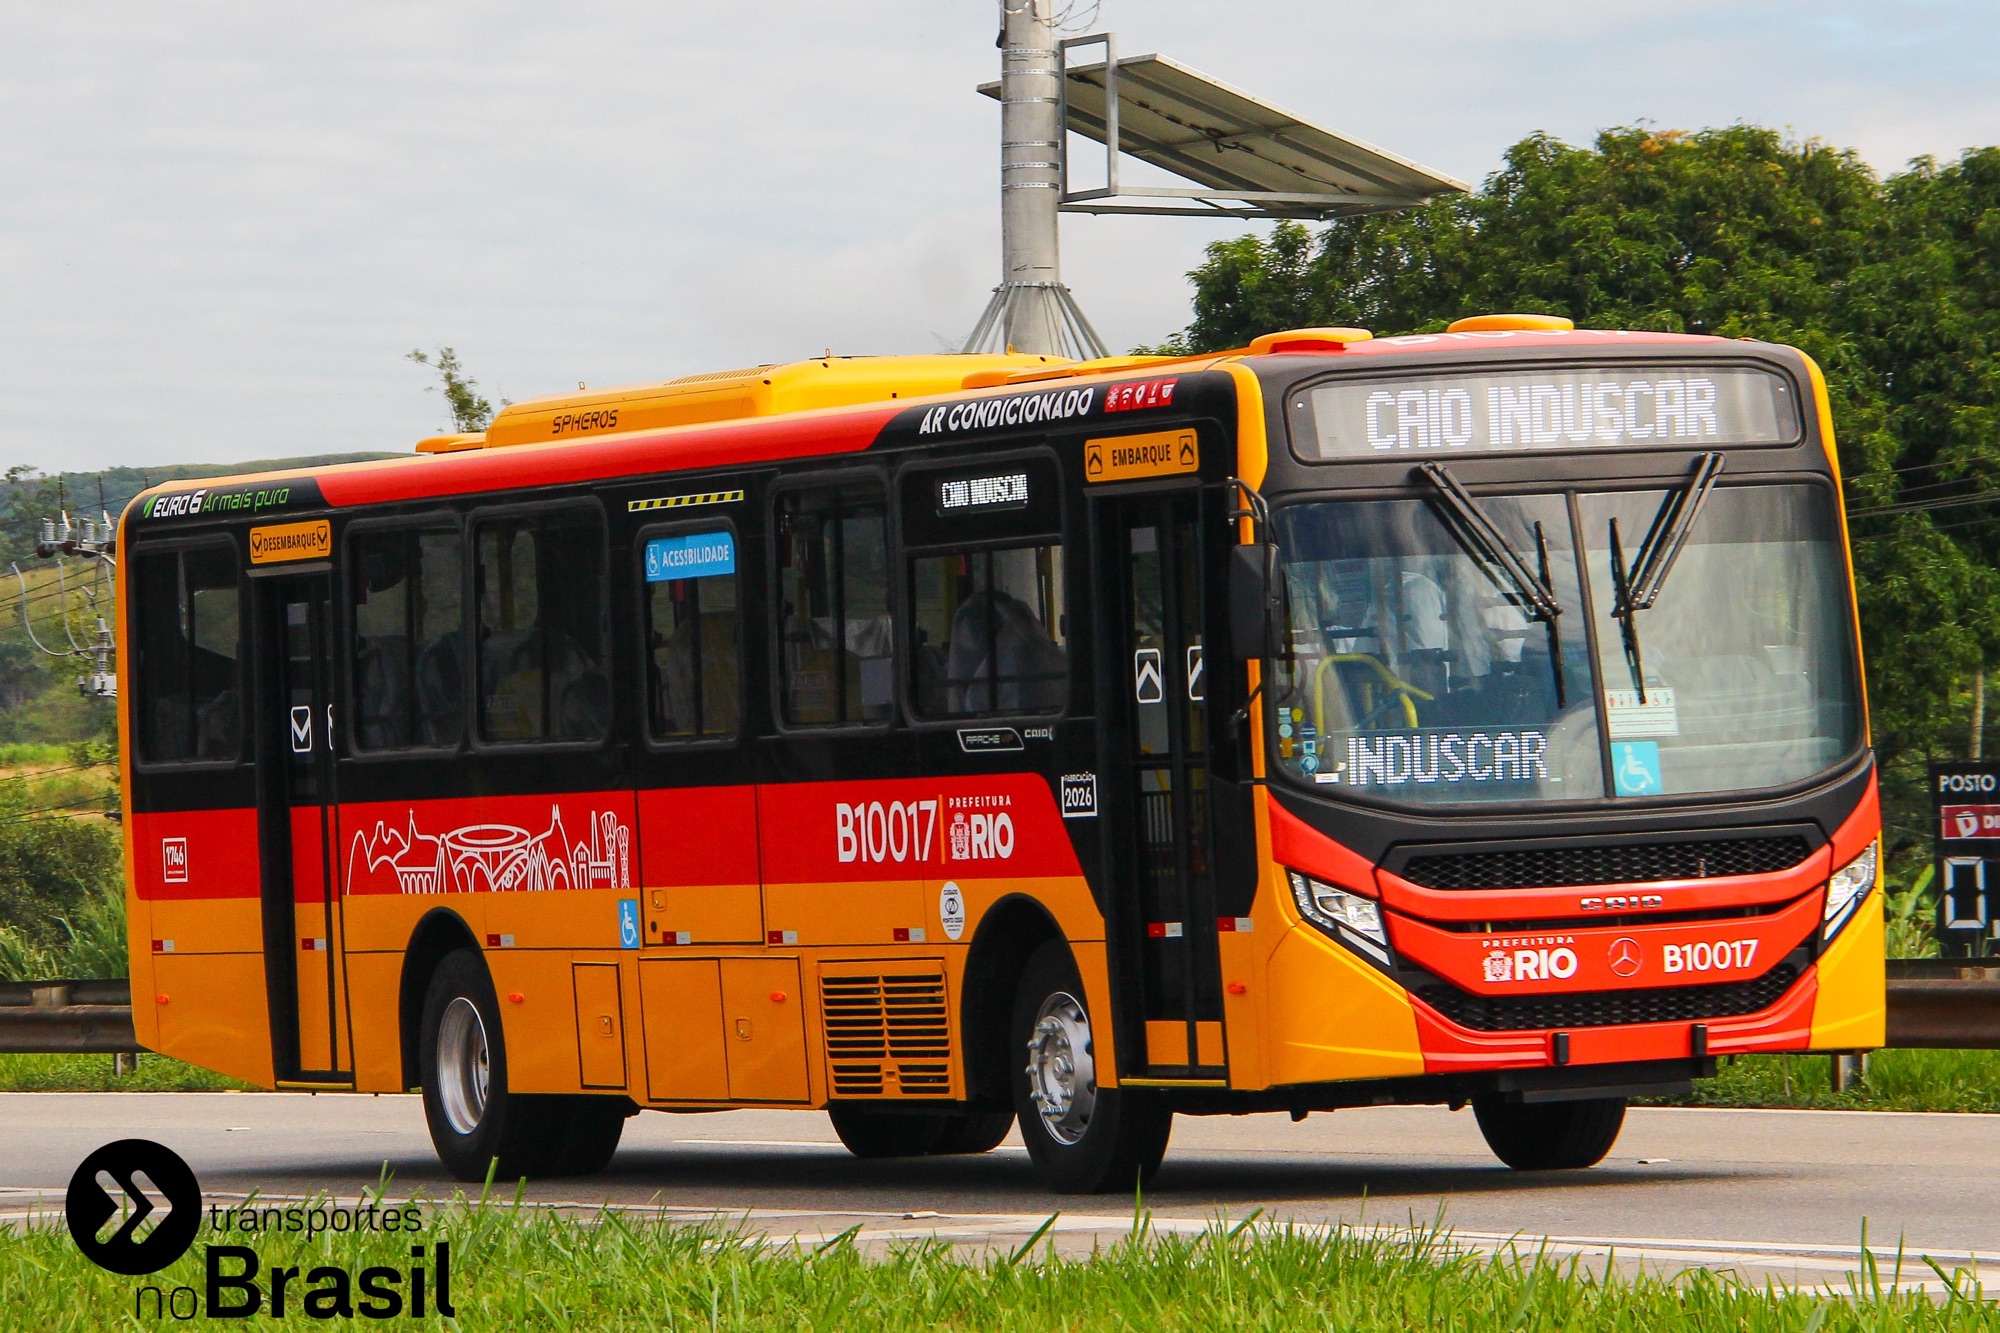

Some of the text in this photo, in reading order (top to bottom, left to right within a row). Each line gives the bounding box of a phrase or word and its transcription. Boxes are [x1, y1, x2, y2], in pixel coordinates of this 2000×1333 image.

[552, 409, 619, 434] SPHEROS
[919, 387, 1095, 435] AR CONDICIONADO
[1366, 378, 1717, 450] CAIO INDUSCAR
[1112, 444, 1171, 467] EMBARQUE
[254, 488, 290, 512] puro
[263, 533, 317, 552] DESEMBARQUE
[966, 735, 1000, 744] APACHE
[1024, 729, 1048, 738] CAIO
[1347, 730, 1548, 786] INDUSCAR
[1939, 774, 1996, 792] POSTO
[949, 795, 1012, 808] PREFEITURA
[1065, 787, 1092, 807] 2026
[836, 800, 937, 863] B10017
[970, 812, 1014, 860] RIO
[166, 846, 184, 866] 1746
[1580, 895, 1662, 911] CAIO
[1482, 936, 1574, 948] PREFEITURA
[1515, 948, 1578, 980] RIO
[1663, 939, 1759, 973] B10017
